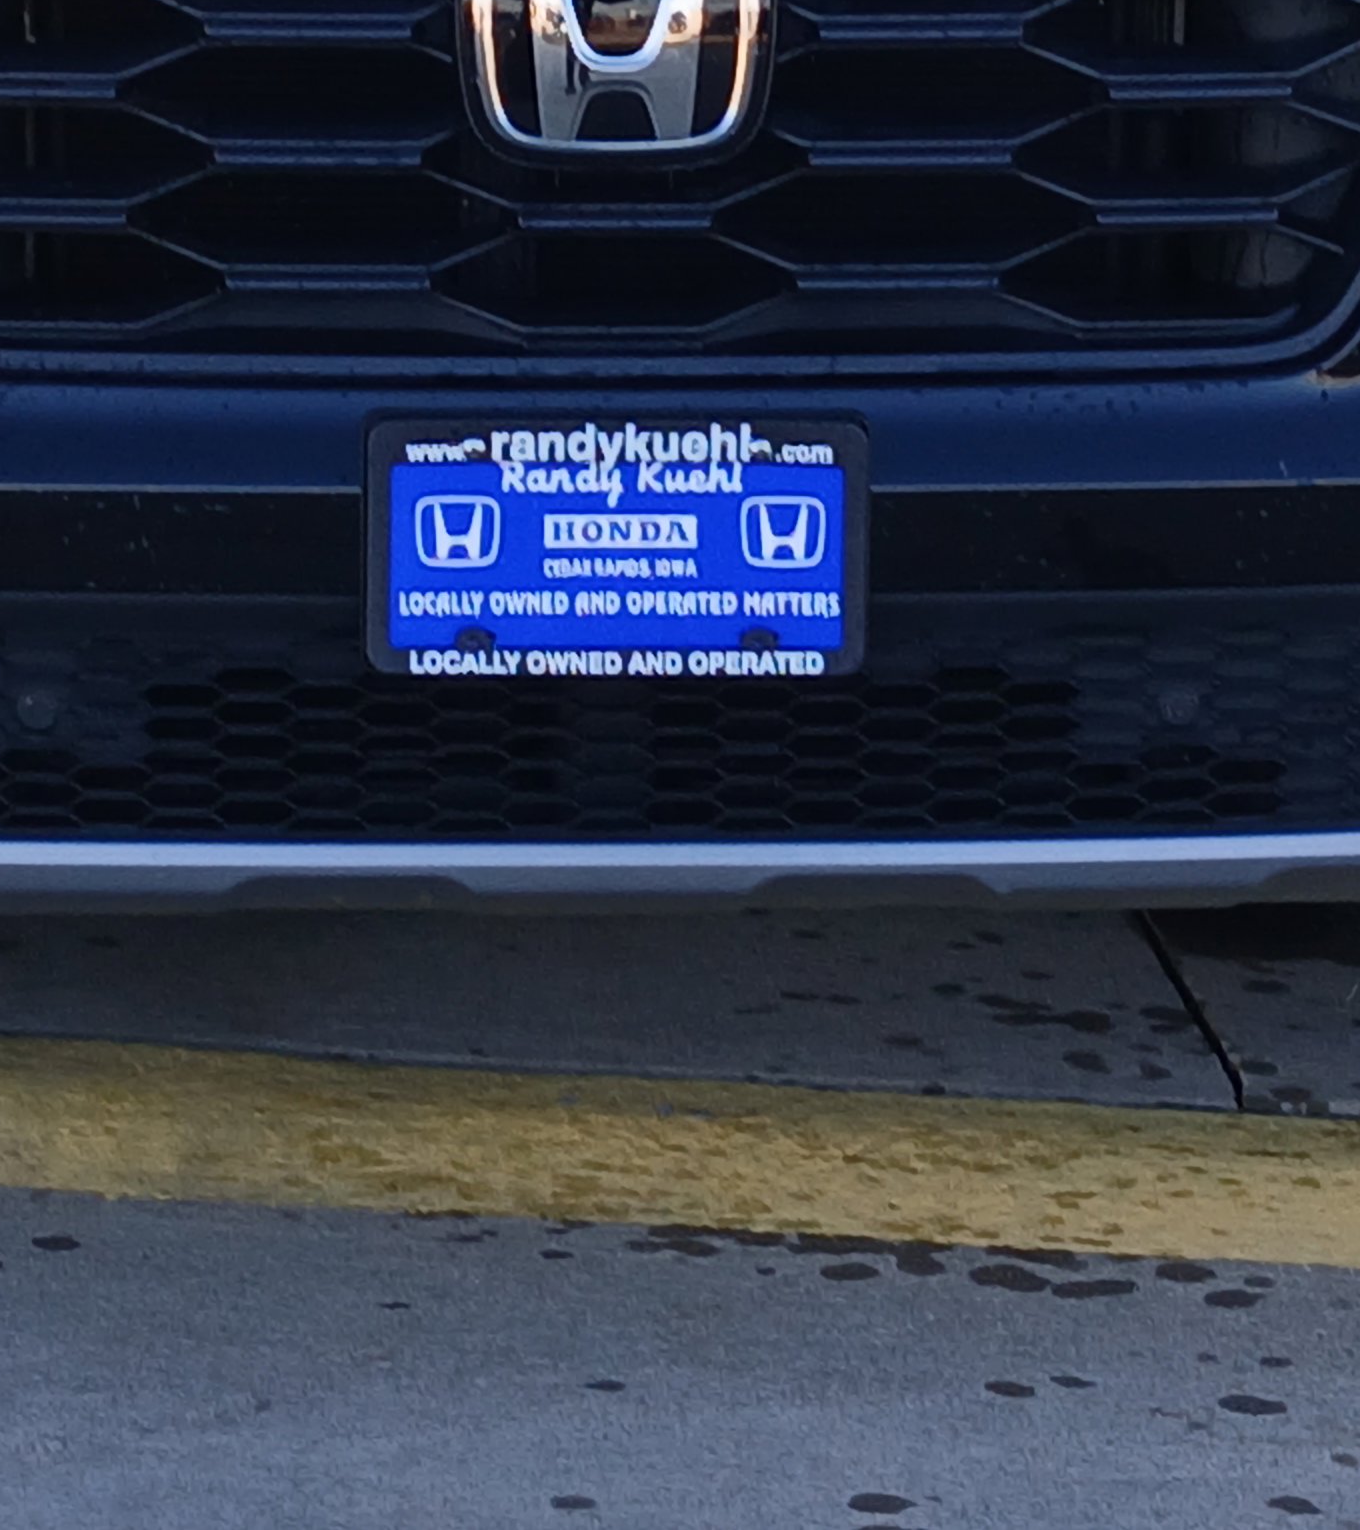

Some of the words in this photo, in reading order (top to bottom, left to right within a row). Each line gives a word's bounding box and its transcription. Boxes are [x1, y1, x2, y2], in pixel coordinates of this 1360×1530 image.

[500, 460, 624, 508] Randy
[637, 460, 743, 494] Kuehl
[552, 520, 690, 543] HONDA
[398, 590, 484, 618] LOCALLY
[489, 590, 570, 617] OWNED
[574, 590, 621, 617] AND
[625, 590, 738, 617] OPERATED
[743, 590, 840, 618] MATTERS
[409, 649, 521, 676] LOCALLY
[526, 649, 623, 676] OWNED
[627, 650, 684, 676] AND
[687, 650, 825, 676] OPERATED
